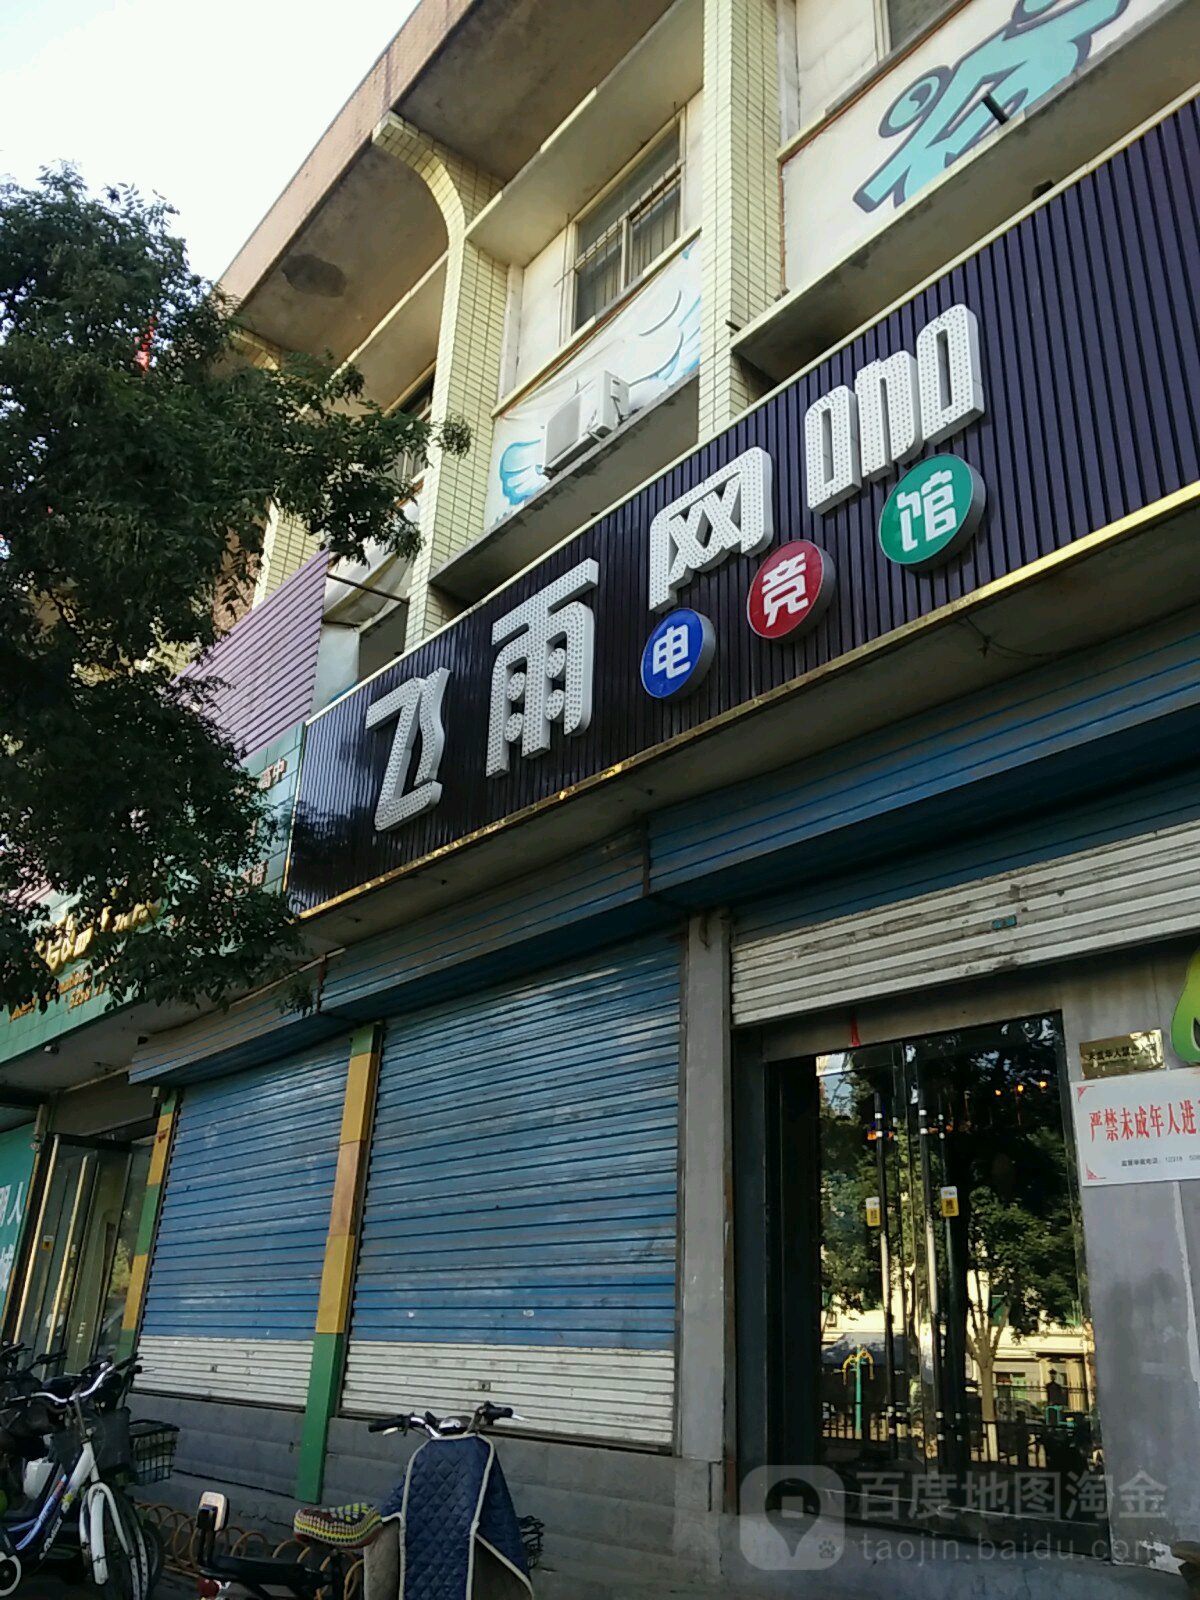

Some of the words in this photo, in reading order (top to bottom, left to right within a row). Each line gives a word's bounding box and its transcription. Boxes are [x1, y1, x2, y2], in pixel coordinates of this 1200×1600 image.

[365, 303, 985, 832] 飞雨网咖
[652, 468, 957, 681] 电竞馆
[1089, 1099, 1200, 1143] 严禁未成年人进
